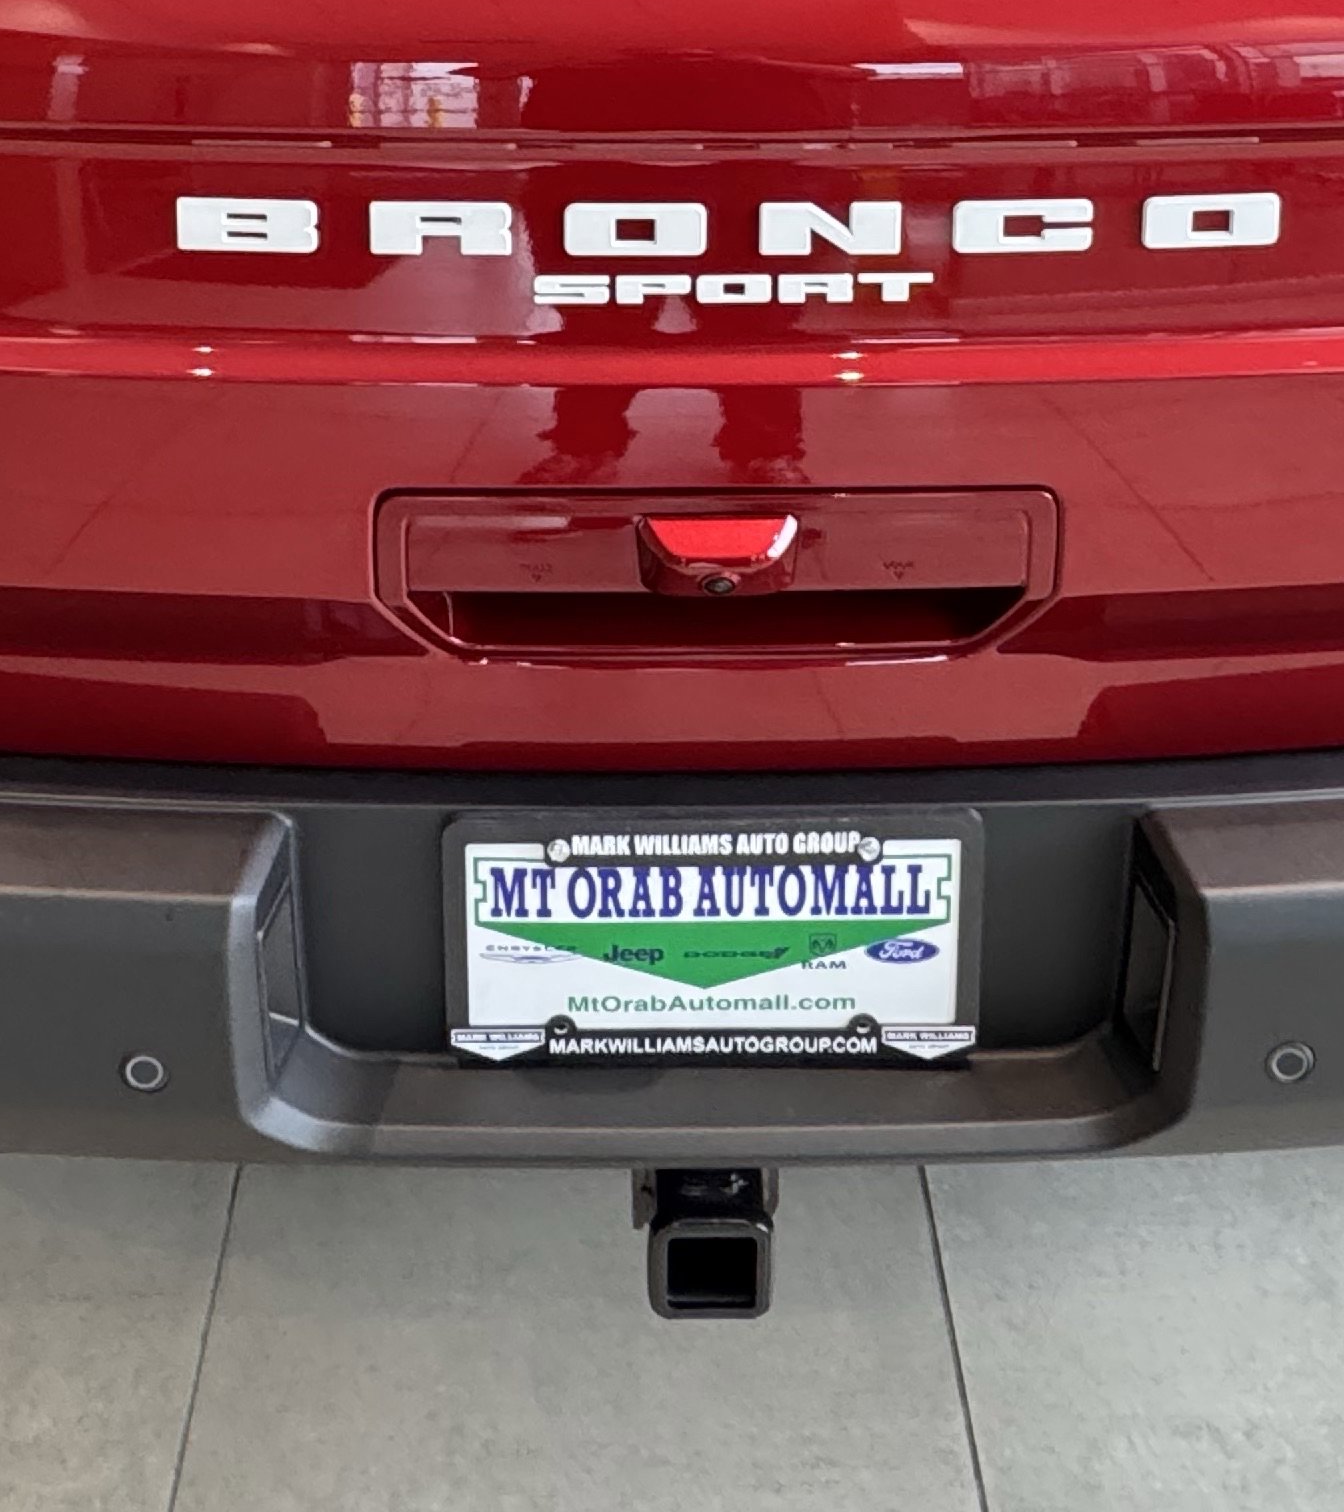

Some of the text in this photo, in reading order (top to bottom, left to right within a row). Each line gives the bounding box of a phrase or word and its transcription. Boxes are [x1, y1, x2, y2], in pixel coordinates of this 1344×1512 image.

[174, 193, 1280, 255] BRONCO
[533, 273, 934, 306] SPORT
[572, 831, 860, 856] MARK WILLIAMS AUTO GROUP
[490, 864, 931, 919] MT ORAB AUTOMALL
[603, 944, 664, 965] Jeep
[801, 960, 846, 970] RAM
[568, 994, 856, 1012] MtOrabAutomall.com
[549, 1036, 877, 1055] MARKWILLIAMSAUTOGROUP.COM
